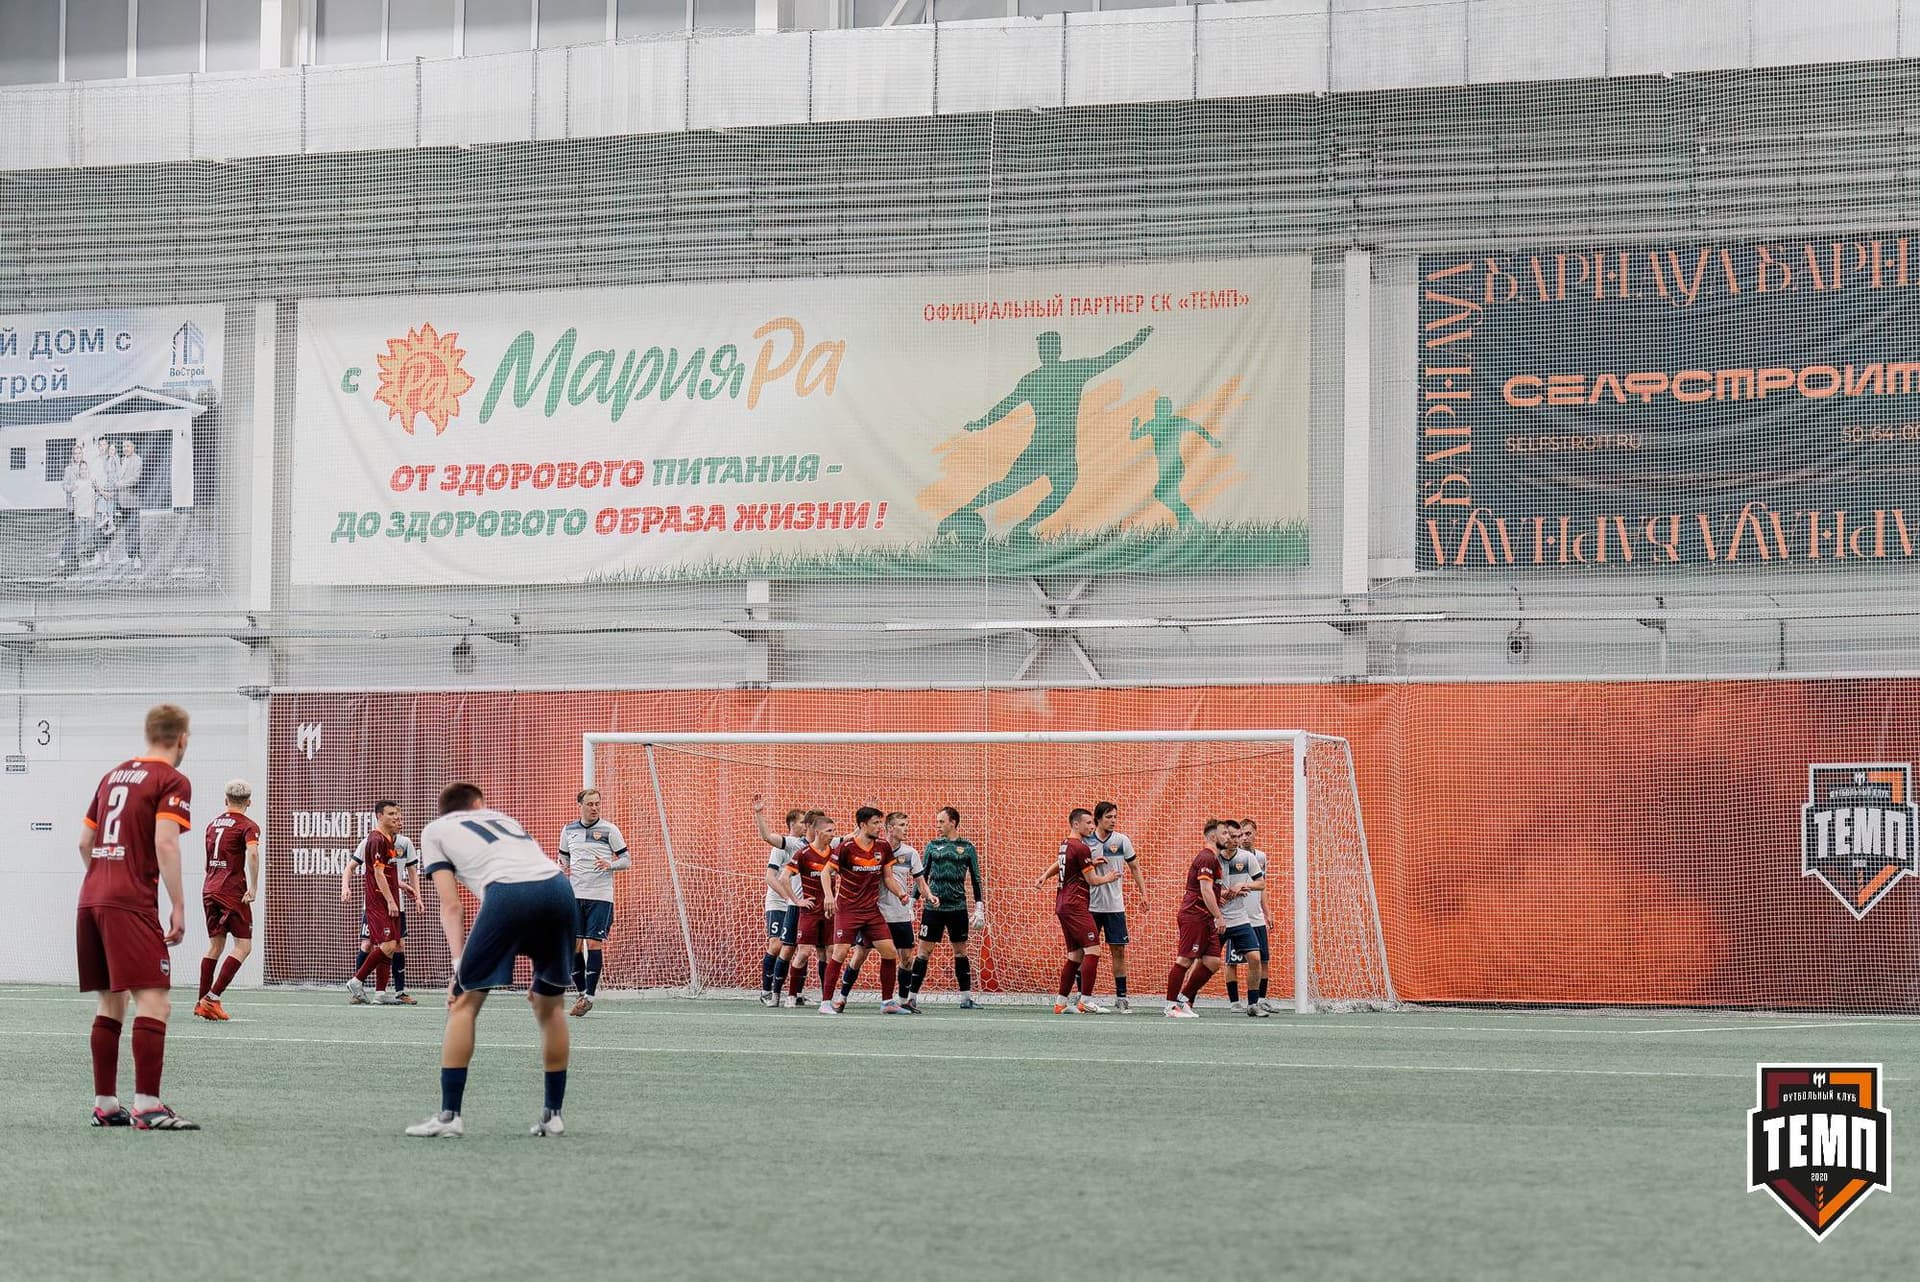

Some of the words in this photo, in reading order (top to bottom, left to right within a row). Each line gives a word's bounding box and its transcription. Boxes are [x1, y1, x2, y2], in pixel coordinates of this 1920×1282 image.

[923, 293, 1063, 325] ОФИЦИАЛЬНЫЙ
[1069, 294, 1144, 316] ПАРТНЕР
[1150, 292, 1172, 312] СК
[1177, 288, 1250, 311] «ТЕМП»
[29, 328, 104, 360] ДОМ
[389, 464, 437, 493] ОТ
[439, 459, 645, 497] ЗДОРОВОГО
[651, 453, 819, 487] ПИТАНИЯ
[330, 511, 381, 544] ДО
[385, 506, 588, 544] ЗДОРОВОГО
[594, 504, 727, 535] ОБРАЗА
[37, 719, 51, 746] 3
[102, 785, 129, 844] 2
[292, 810, 352, 838] ТОЛЬКО
[1814, 807, 1907, 860] ТЕМП
[292, 848, 350, 875] ТОЛЬКО
